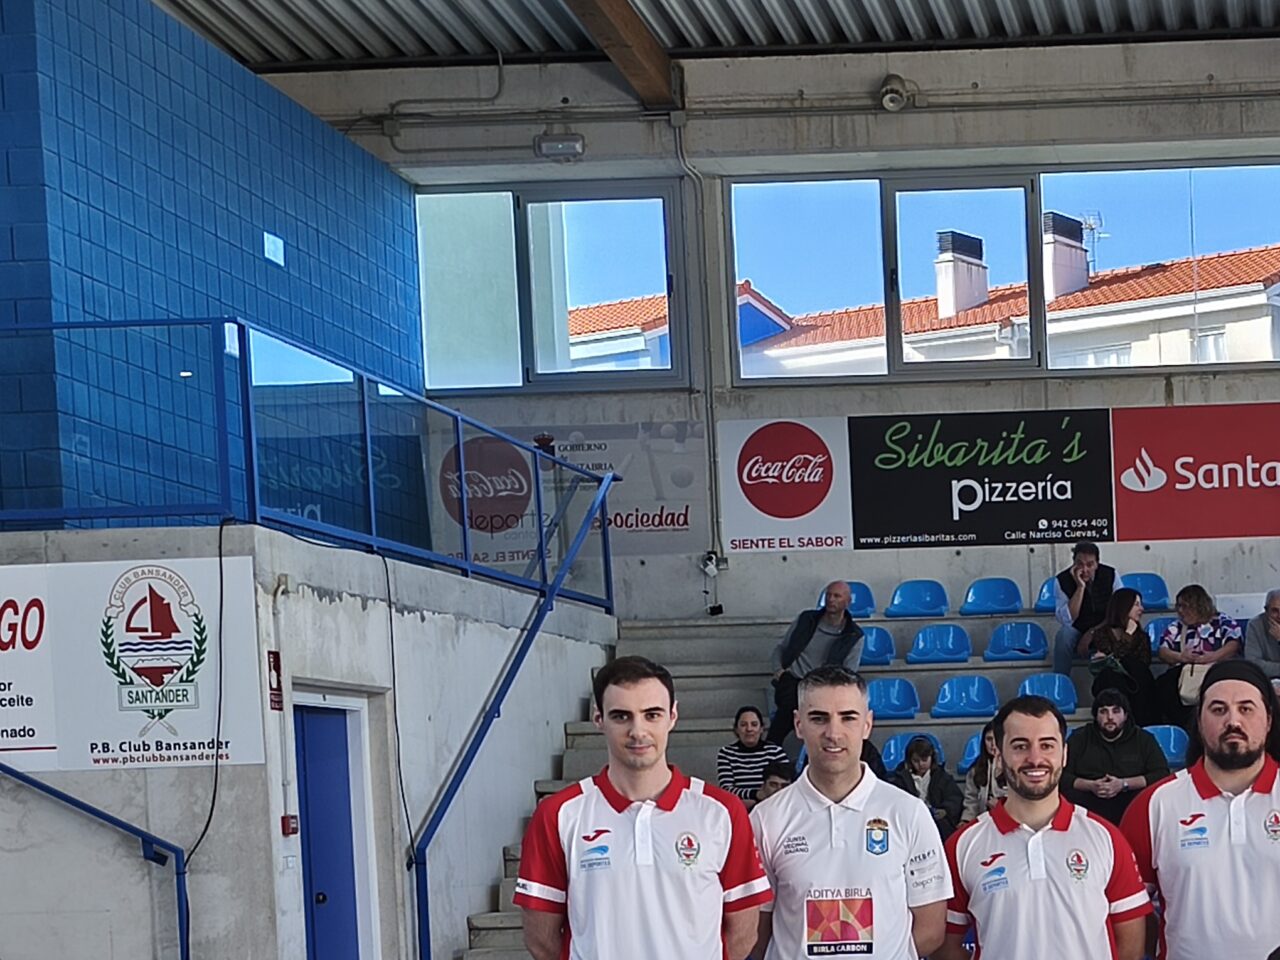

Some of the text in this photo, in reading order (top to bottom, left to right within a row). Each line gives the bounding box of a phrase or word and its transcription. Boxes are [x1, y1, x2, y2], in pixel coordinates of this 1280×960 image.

[558, 443, 607, 452] GOBIERNO
[874, 416, 1087, 470] Sibarita's
[742, 454, 828, 485] Coca-Cola
[951, 474, 1072, 521] pizzería
[1052, 519, 1108, 528] 942 054 400
[1004, 530, 1026, 540] Calle
[1029, 529, 1062, 539] Narciso
[1064, 529, 1100, 539] Cuevas,
[730, 535, 843, 550] SIENTE EL SABOR
[113, 568, 188, 601] CLUB BANSANDER
[127, 689, 189, 704] SANTANDER
[90, 739, 230, 754] P.B. Club Bansander
[92, 752, 230, 765] www.pbclubbansanderes
[806, 887, 872, 899] ADITYA BIRLA
[836, 944, 867, 952] CARBON
